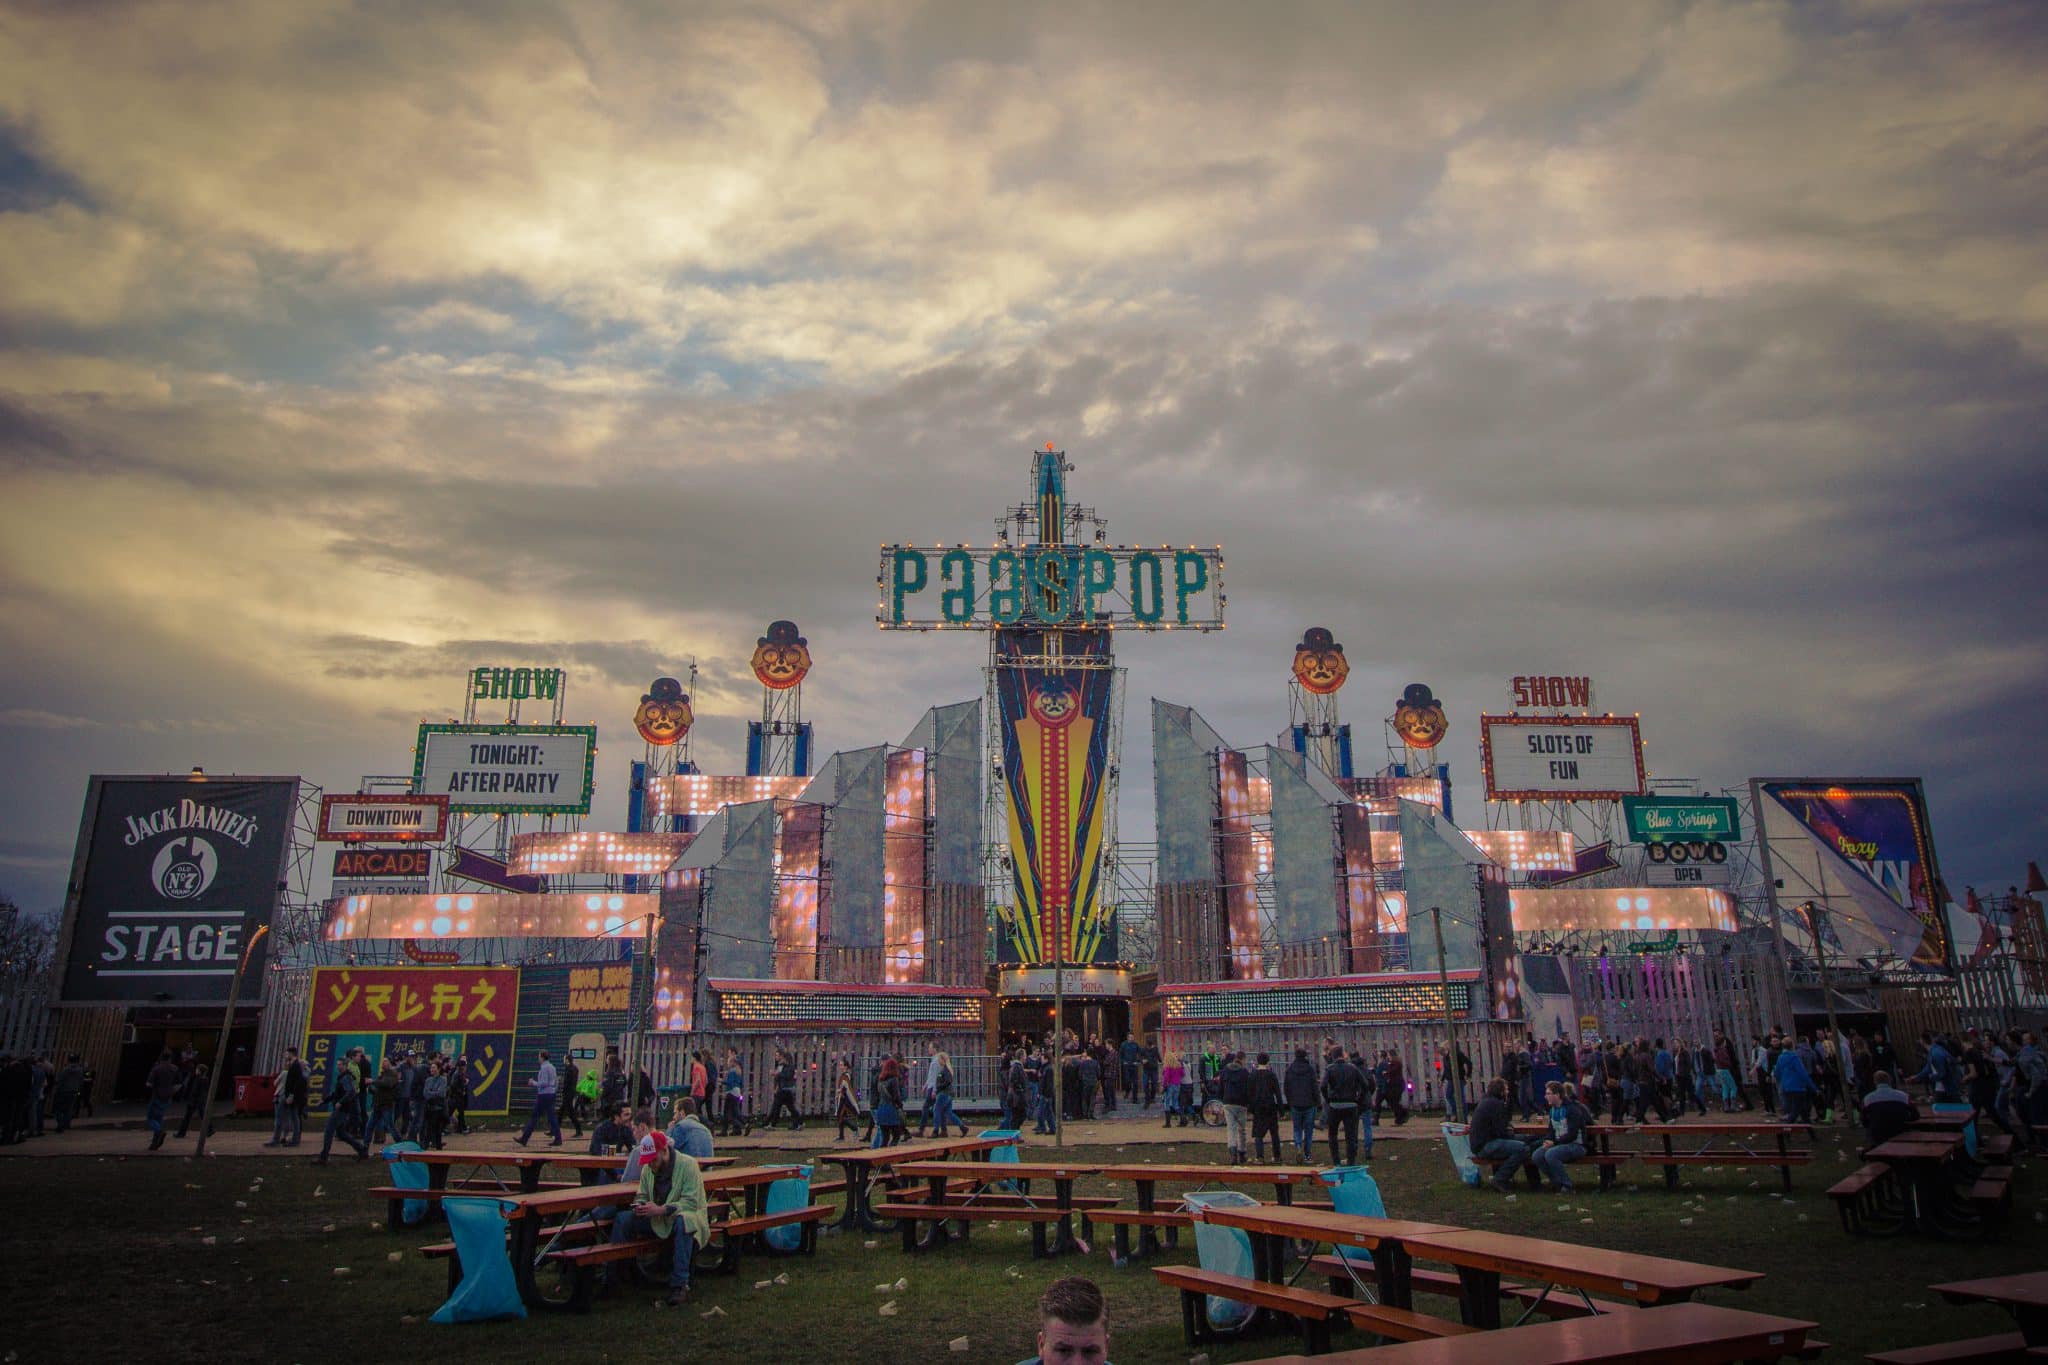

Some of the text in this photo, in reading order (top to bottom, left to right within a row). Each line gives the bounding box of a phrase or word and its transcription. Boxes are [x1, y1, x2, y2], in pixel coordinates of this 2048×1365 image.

[473, 667, 560, 700] SHOW
[1513, 676, 1590, 707] SHOW
[470, 744, 544, 765] TONIGHT:
[1528, 735, 1593, 754] SLOTS OF
[1549, 760, 1579, 780] FUN
[448, 772, 560, 793] AFTER PARTY
[124, 806, 177, 846] JACK
[346, 809, 422, 826] DOWNTOWN
[1645, 809, 1718, 831] Blue Springs
[1652, 843, 1725, 861] BOWL
[336, 854, 428, 873] ARCADE
[1674, 867, 1703, 882] OPEN
[101, 924, 242, 962] STAGE
